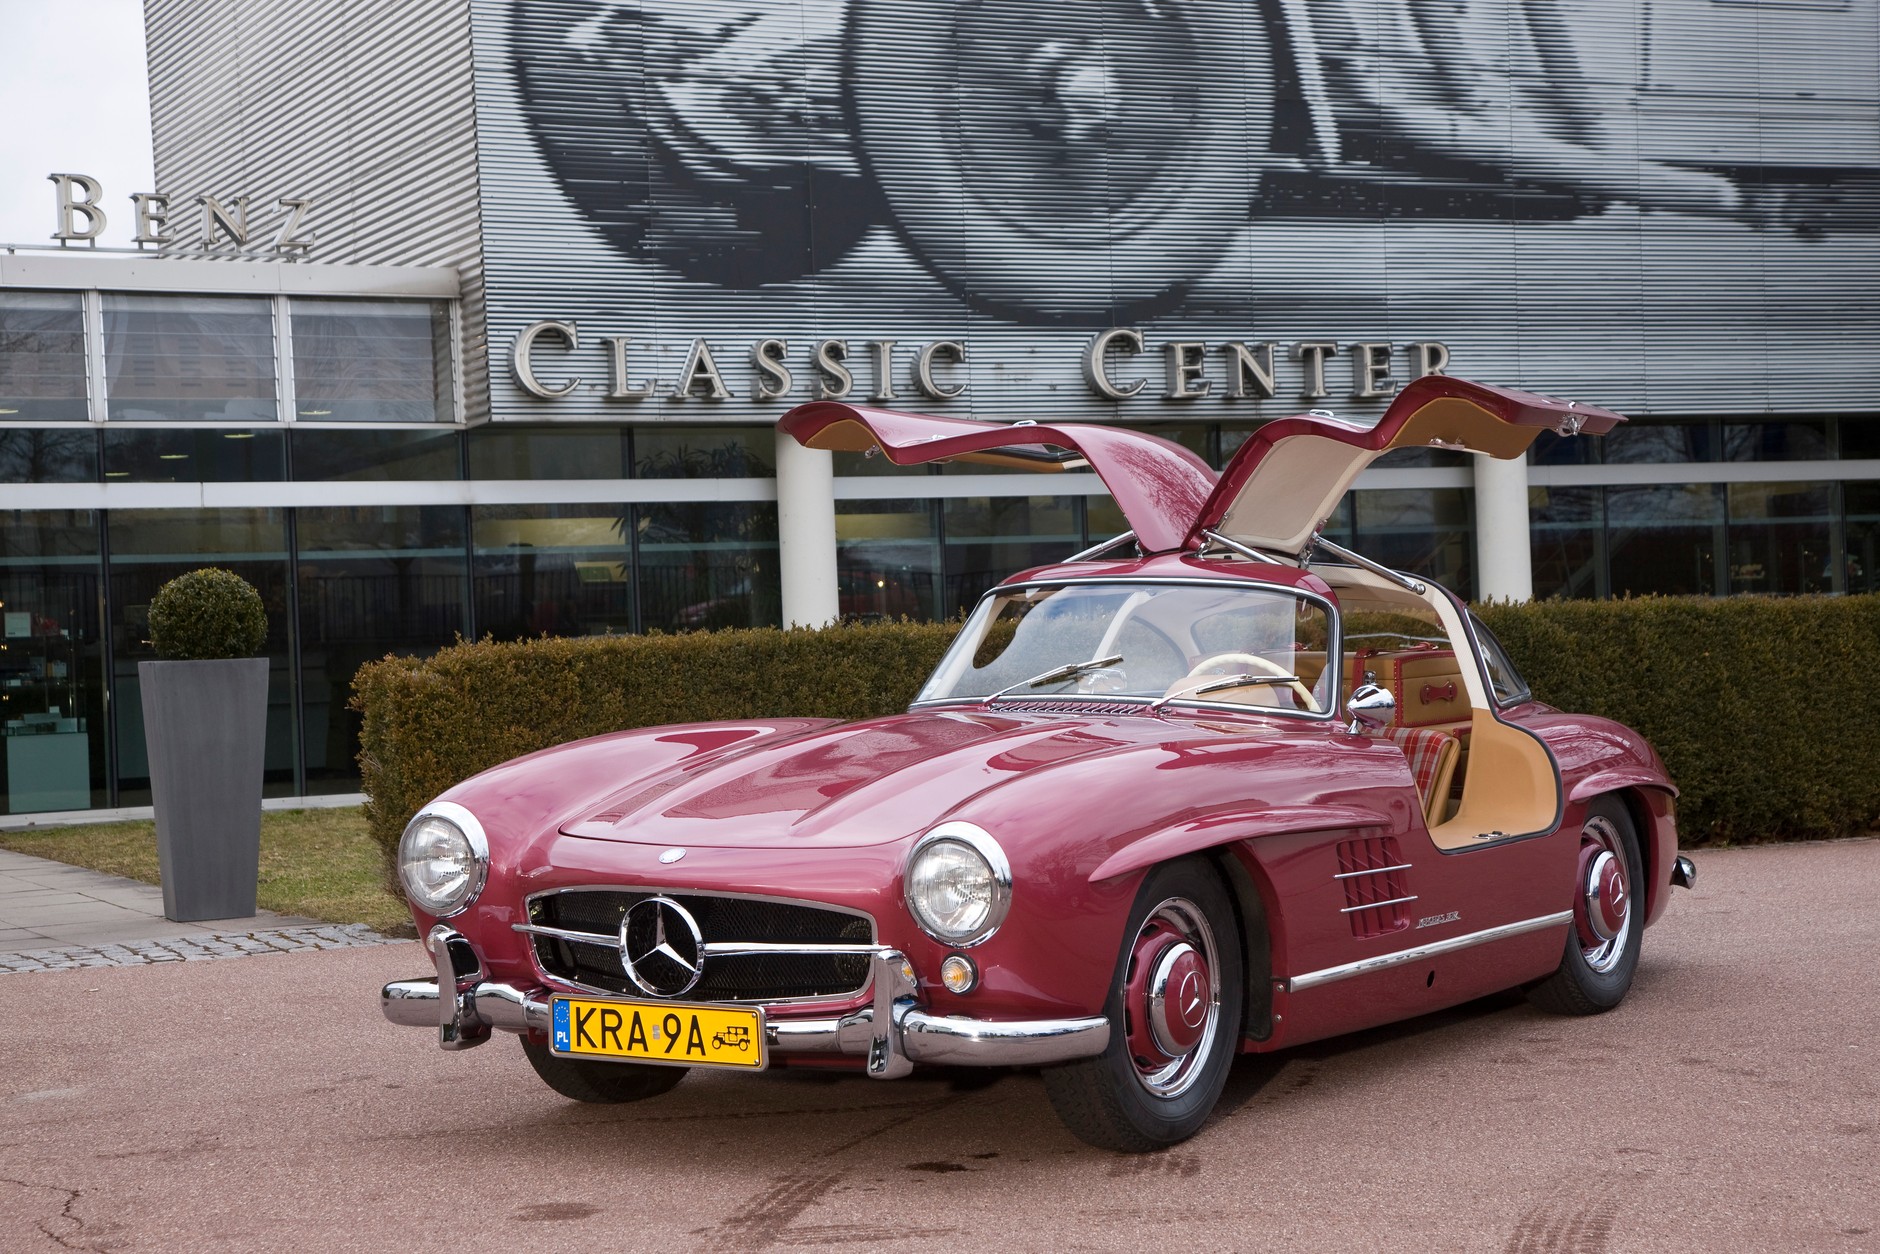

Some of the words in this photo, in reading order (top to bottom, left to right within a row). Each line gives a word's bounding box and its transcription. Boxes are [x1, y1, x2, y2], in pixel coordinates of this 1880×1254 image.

[47, 173, 316, 247] BENZ
[508, 319, 967, 400] CLASSIC
[1081, 328, 1450, 398] CENTER
[556, 1031, 569, 1043] PL
[575, 1006, 649, 1053] KRA
[663, 1013, 707, 1056] 9A
